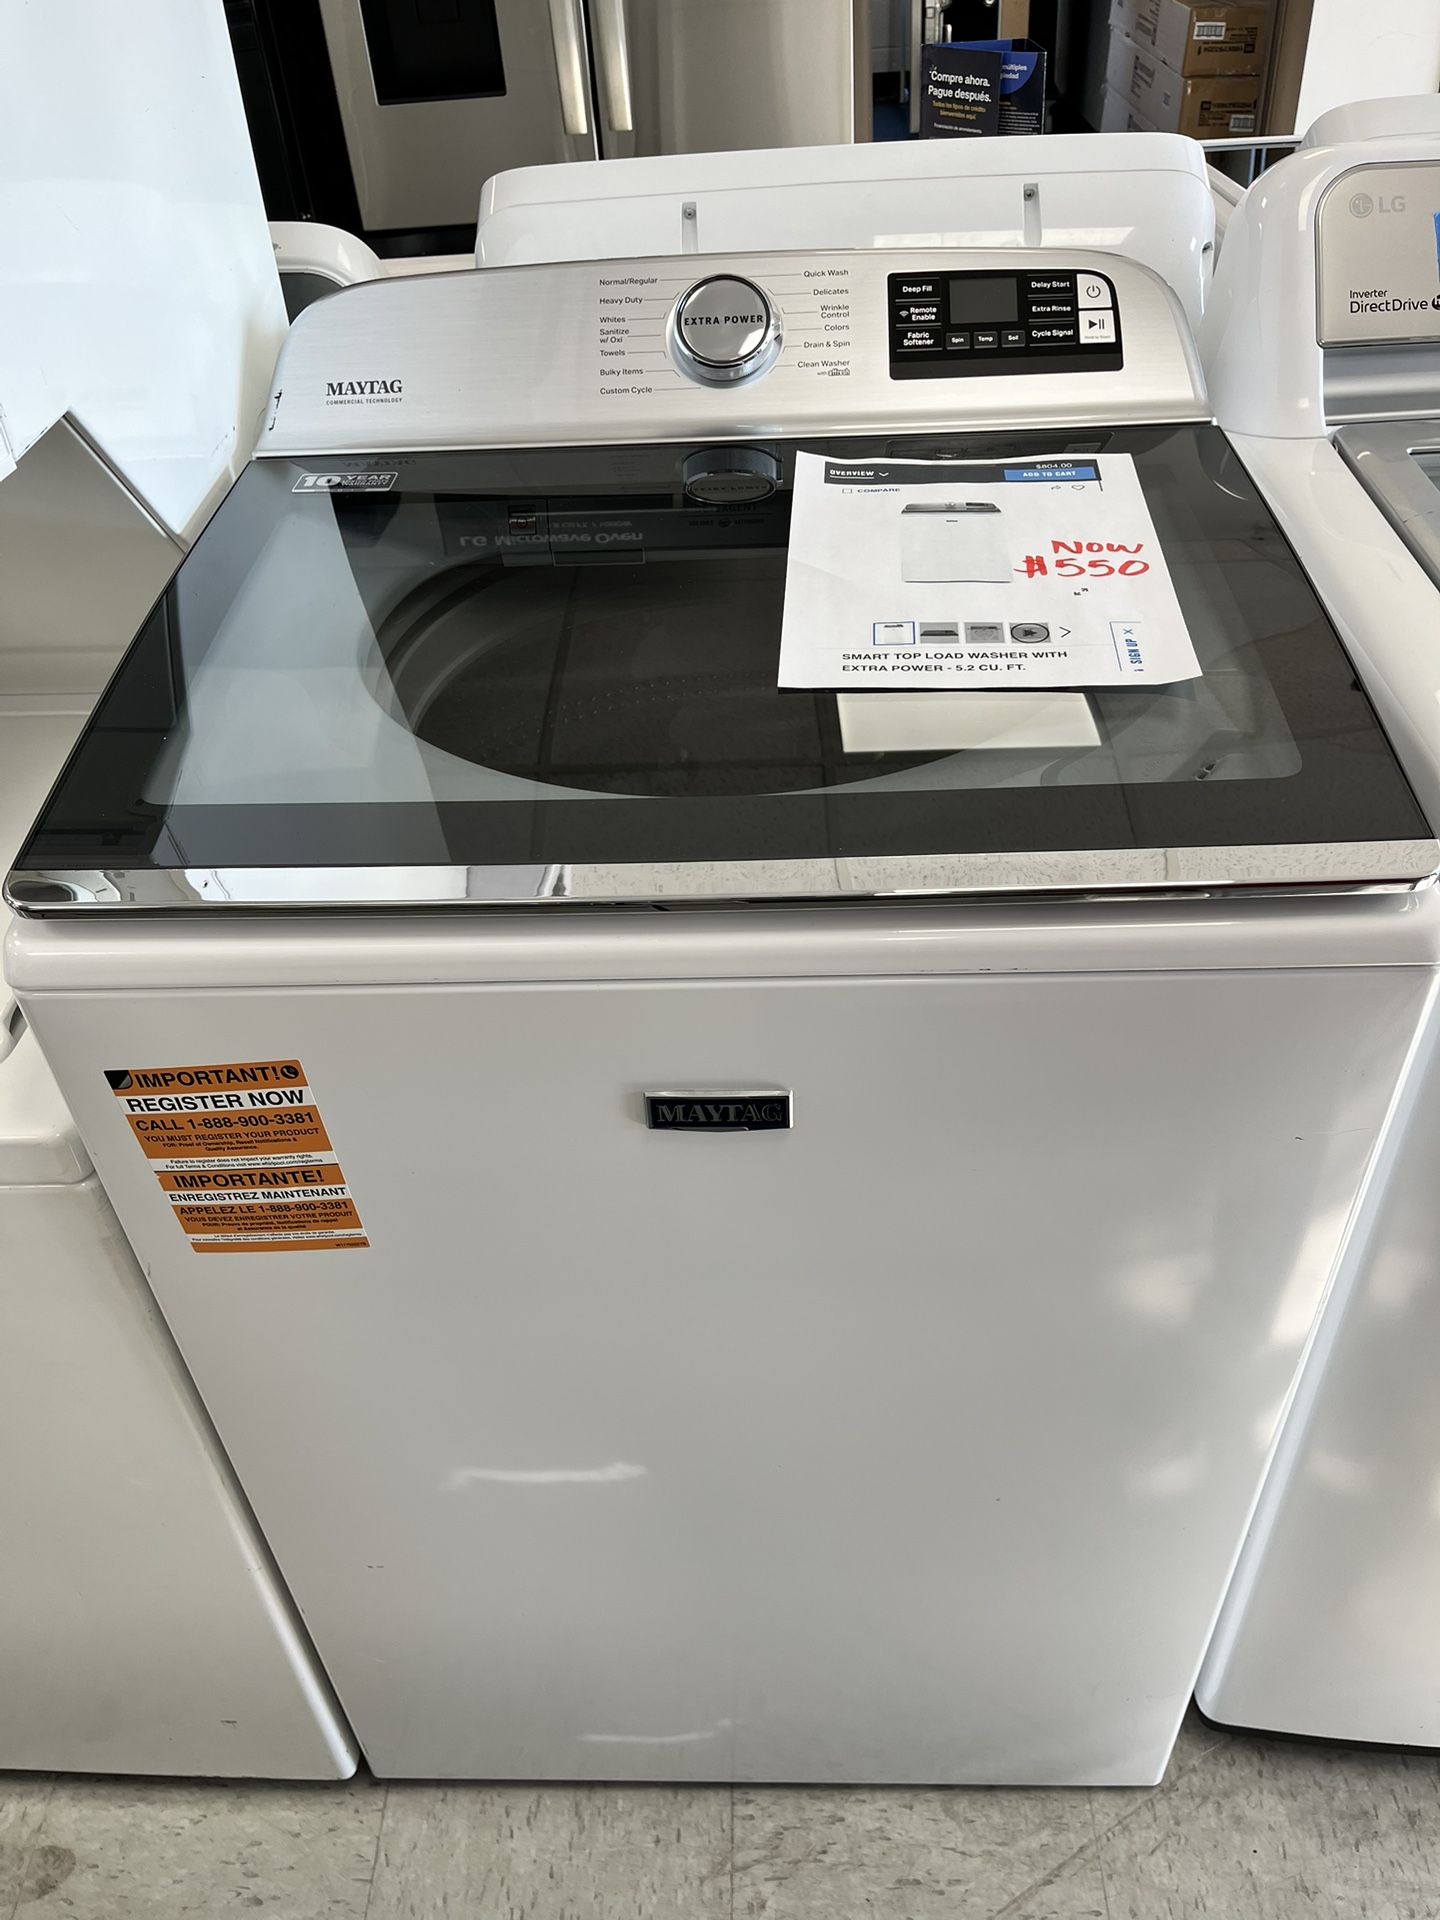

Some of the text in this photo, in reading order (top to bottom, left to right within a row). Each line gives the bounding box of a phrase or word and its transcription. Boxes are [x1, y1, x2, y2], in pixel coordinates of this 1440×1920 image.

[931, 70, 991, 87] Compre ahora.
[928, 85, 992, 102] Pague después.
[1379, 195, 1406, 213] LG
[803, 270, 826, 278] Quick
[599, 277, 658, 286] Normal/Regular
[1031, 280, 1070, 289] Delay Start
[813, 288, 849, 296] Delicates
[1349, 289, 1388, 299] Inverter
[600, 296, 643, 305] Heavy Duty
[1031, 305, 1051, 313] Extra
[821, 311, 850, 319] Control
[684, 315, 764, 326] EXTRA POWER
[599, 328, 630, 336] Sanitize
[907, 331, 930, 339] Fabric
[1031, 329, 1074, 338] Cycle Signal
[600, 336, 623, 344] w/ Oxi
[803, 341, 824, 349] Drain
[832, 340, 851, 348] Spin
[600, 368, 620, 377] Bulky
[326, 379, 403, 397] MAYTAG
[600, 386, 653, 395] Custom Cycle
[326, 398, 364, 406] COMMERCIAL
[829, 469, 875, 477] OVERVIEW
[303, 475, 342, 487] 10
[925, 652, 964, 660] LOAD
[968, 651, 1028, 660] WASHER
[1031, 651, 1068, 659] WITH
[1125, 638, 1143, 664] SIGN UP
[842, 664, 888, 672] EXTRA
[891, 664, 943, 672] POWER
[955, 664, 975, 672] 5.2
[1006, 663, 1026, 671] FT.
[134, 1066, 280, 1088] IMPORTANT!
[126, 1089, 304, 1113] REGISTER NOW
[655, 1103, 783, 1122] MAYTAG
[135, 1111, 314, 1132] CALL 1-888-900-3381
[144, 1127, 320, 1143] YOU MUST REGISTER YOUR PRODUCT
[172, 1169, 325, 1188] IMPORTANTE!
[169, 1187, 346, 1202] ENREGISTREZ MAINTENANT
[180, 1201, 348, 1215] APPELEZ LE 1-888-900-3381
